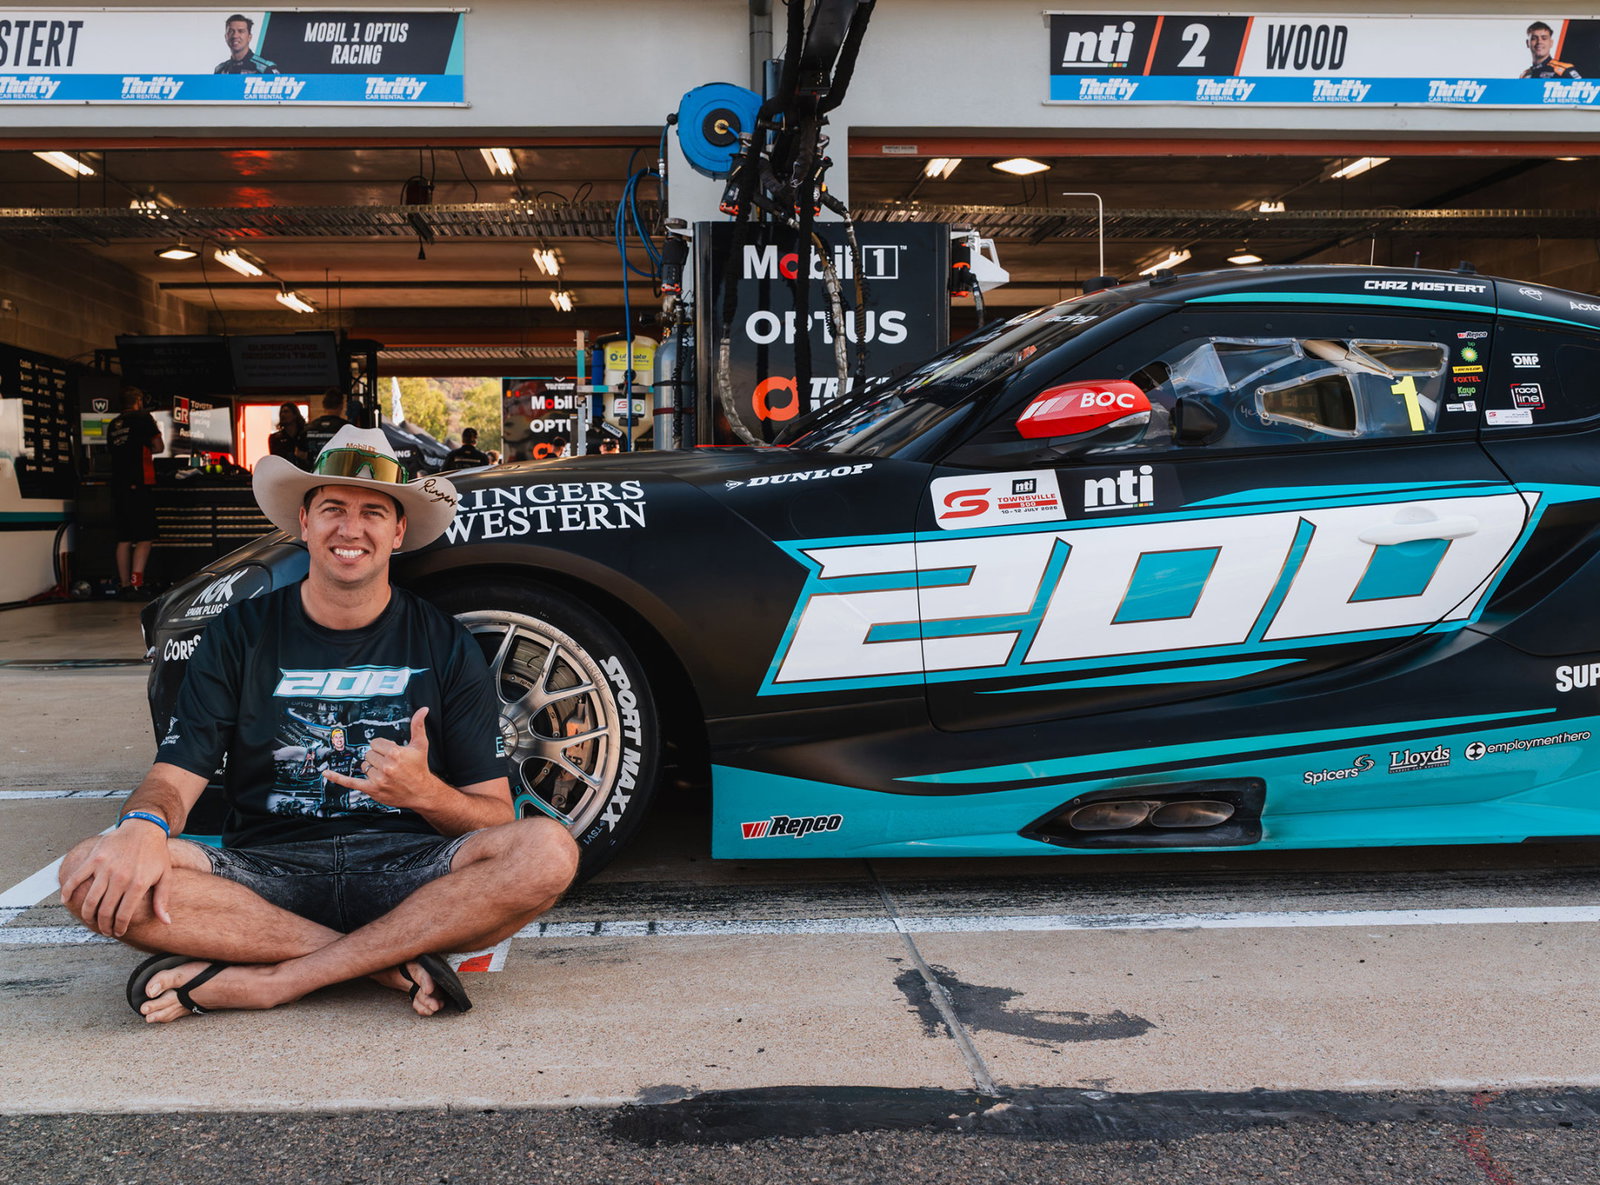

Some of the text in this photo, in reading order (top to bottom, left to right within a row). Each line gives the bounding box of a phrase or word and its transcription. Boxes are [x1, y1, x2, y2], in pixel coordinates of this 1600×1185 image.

[304, 22, 409, 42] MOBIL 1 OPTUS
[1063, 21, 1136, 63] nti
[0, 20, 83, 67] STERT
[331, 45, 382, 64] RACING
[1177, 23, 1211, 67] 2
[1266, 24, 1348, 70] WOOD
[0, 76, 61, 98] Thrifty
[121, 77, 183, 99] Thrifty
[244, 77, 306, 99] Thrifty
[365, 77, 427, 99] Thrifty
[1079, 78, 1140, 100] Thrifty
[1196, 79, 1256, 101] Thrifty
[1312, 80, 1371, 102] Thrifty
[1428, 80, 1487, 102] Thrifty
[1543, 81, 1600, 103] Thrifty
[873, 248, 885, 276] 1
[1364, 280, 1487, 293] CHAZ MOSTERT
[745, 310, 908, 345] OPTUS
[1512, 356, 1539, 365] OMP
[1080, 392, 1135, 408] BOC
[1457, 386, 1476, 396] Kayo
[1516, 394, 1540, 403] line
[531, 396, 572, 409] Mobil
[1391, 376, 1425, 431] 1
[174, 407, 189, 423] GR
[747, 463, 873, 487] DUNLOP
[1016, 480, 1034, 491] nti
[1084, 465, 1153, 507] nti
[997, 493, 1056, 502] TOWNSVILLE
[444, 502, 647, 544] WESTERN
[191, 568, 248, 607] NGK
[777, 490, 1543, 683] 200
[185, 606, 205, 617] SPARK
[1556, 663, 1600, 692] SUP
[600, 656, 642, 832] SPORT MAXX
[1487, 730, 1591, 754] employmenthero
[1390, 745, 1450, 767] Lloyds
[1303, 766, 1359, 785] Spicers
[769, 815, 842, 838] Repco
